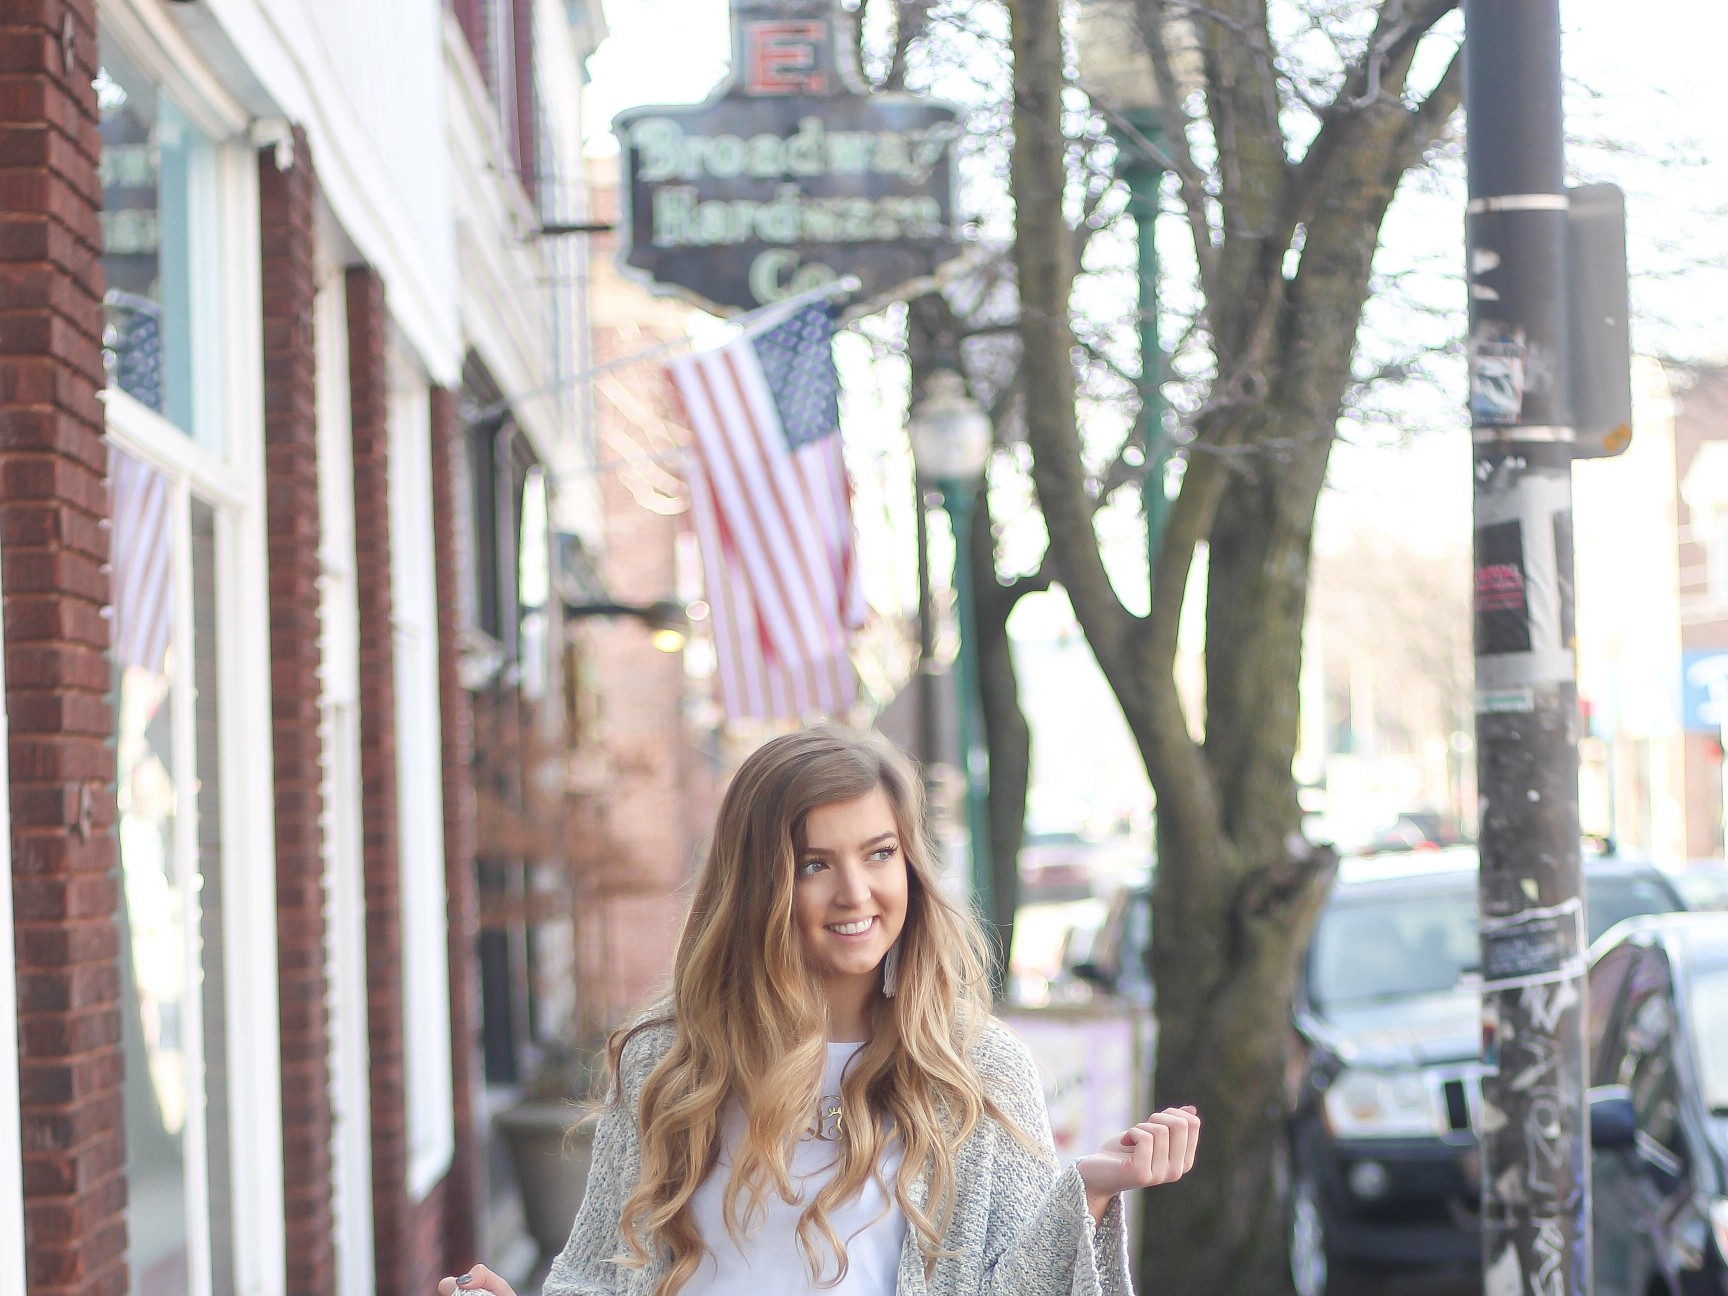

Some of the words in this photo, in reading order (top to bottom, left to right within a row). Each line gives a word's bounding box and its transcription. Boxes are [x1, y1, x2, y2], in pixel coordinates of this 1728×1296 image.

[745, 20, 828, 96] E
[630, 116, 948, 184] Broadway
[651, 182, 944, 247] Hardware
